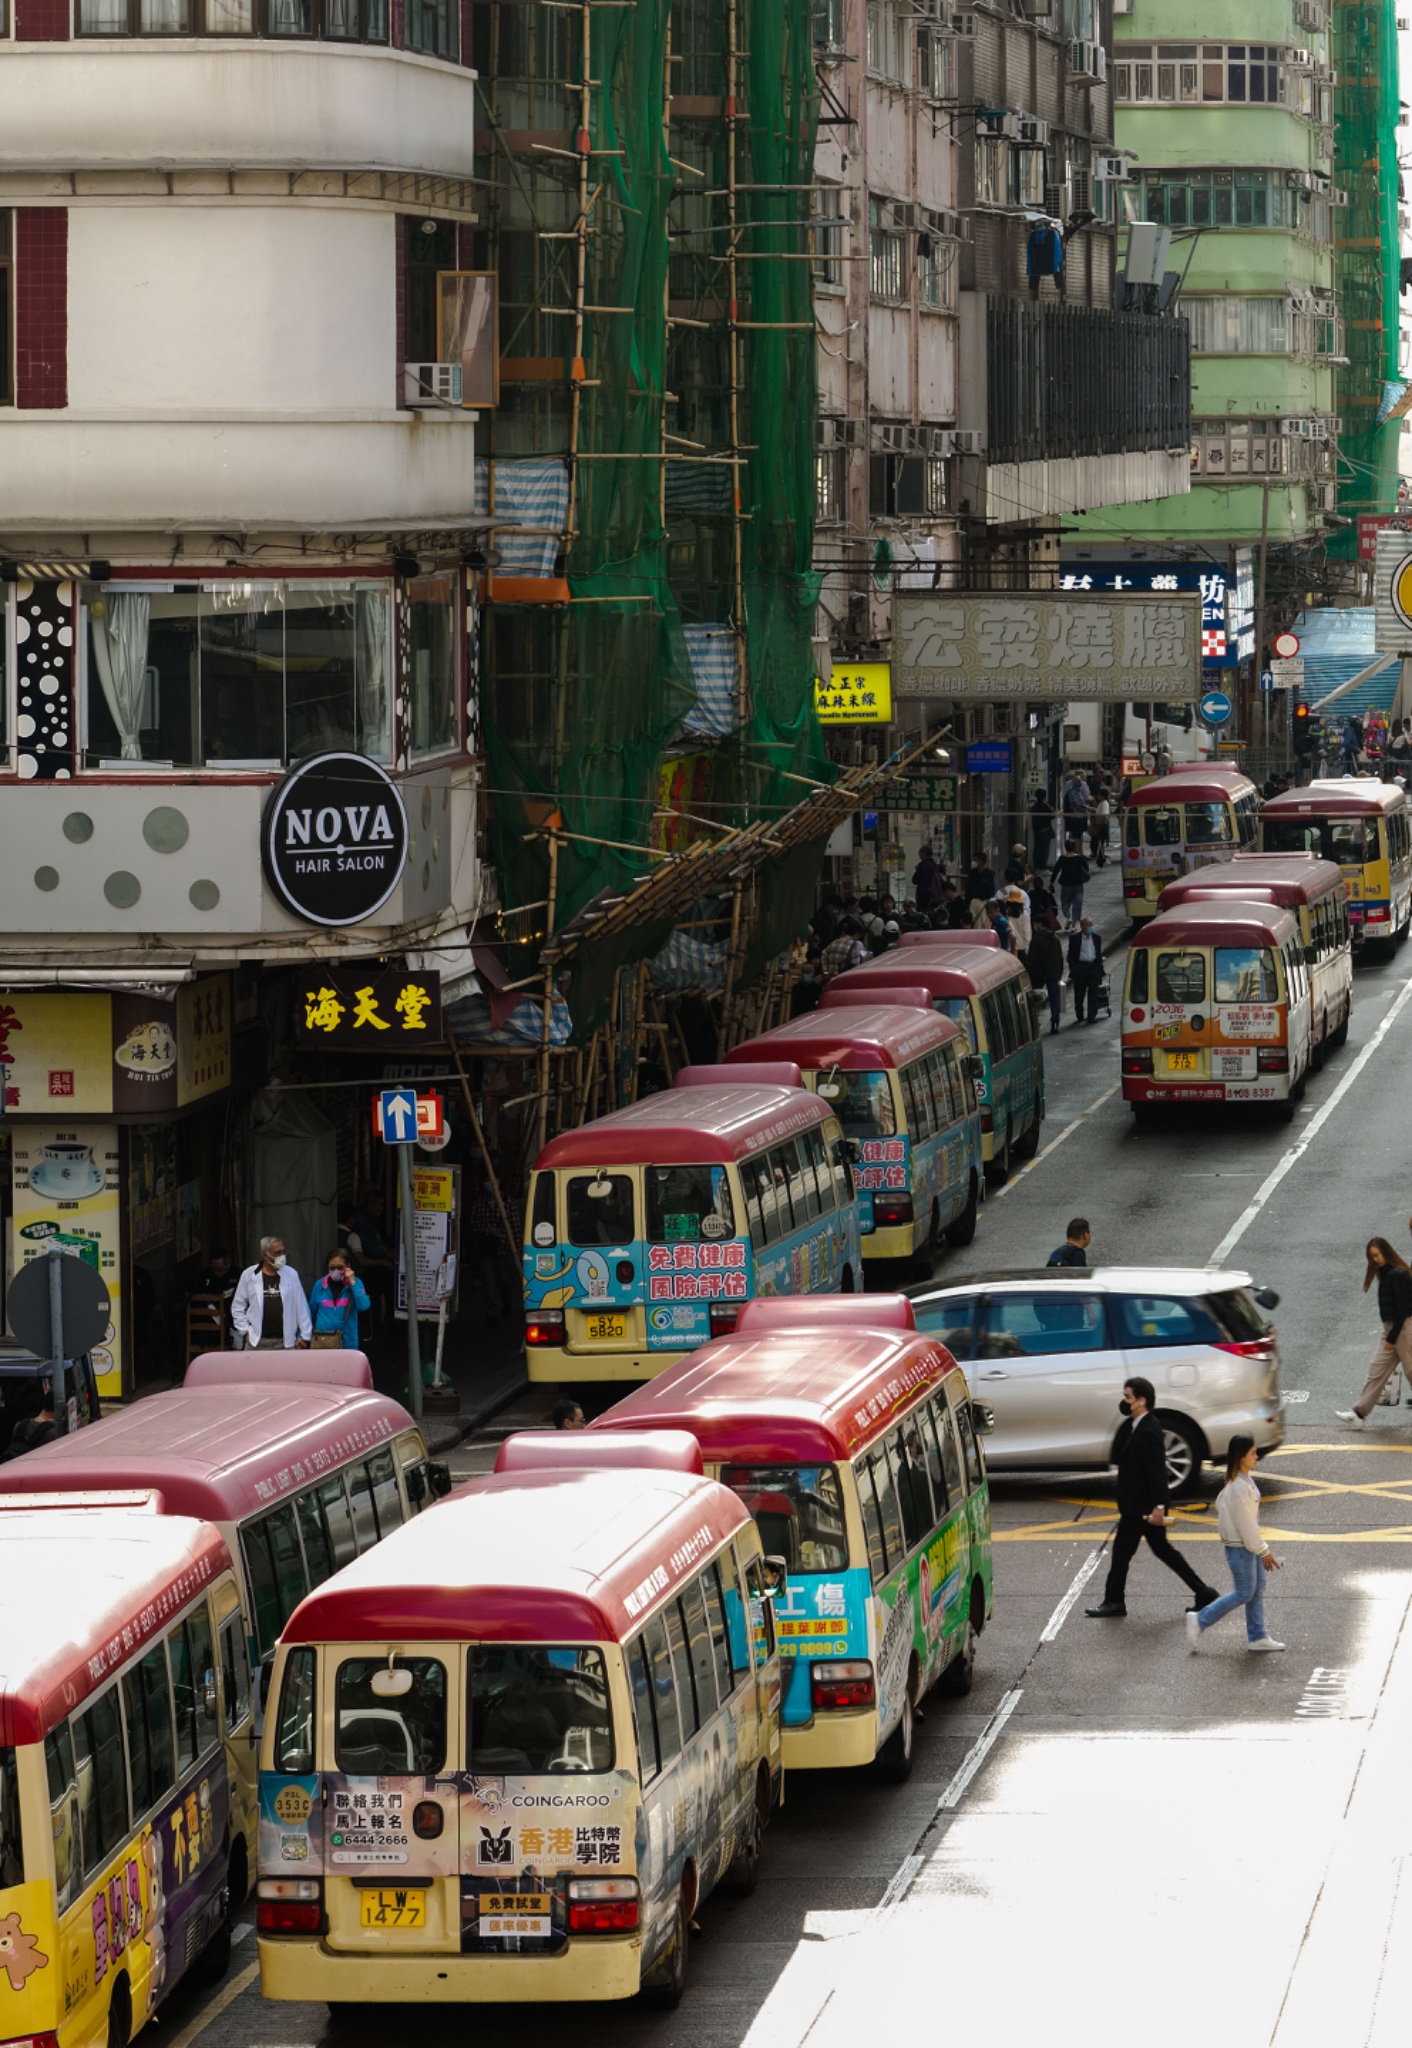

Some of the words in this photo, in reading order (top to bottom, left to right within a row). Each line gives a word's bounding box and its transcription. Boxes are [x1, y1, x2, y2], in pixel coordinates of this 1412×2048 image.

[285, 804, 395, 844] NOVA
[295, 859, 330, 873] HAIR
[337, 856, 384, 871] SALON
[304, 984, 432, 1032] 海天堂
[131, 1042, 172, 1061] 海天堂
[1173, 1061, 1191, 1069] 712
[858, 1141, 905, 1162] 健康
[649, 1244, 745, 1270] 免費健康
[651, 1273, 746, 1299] 風險評估
[598, 1317, 614, 1327] SY
[800, 1641, 832, 1655] 9999
[277, 1800, 309, 1811] 353C
[336, 1794, 402, 1808] 聯絡我們
[512, 1796, 610, 1806] COINGAROO
[336, 1815, 402, 1829] 馬上報名
[345, 1836, 374, 1845] 6444
[379, 1836, 408, 1845] 2666
[519, 1827, 574, 1855] 香港
[576, 1826, 621, 1841] 比特幣
[576, 1843, 620, 1864] 學院
[379, 1892, 407, 1907] LW
[489, 1897, 541, 1909] 免費試堂
[367, 1908, 420, 1924] 1477
